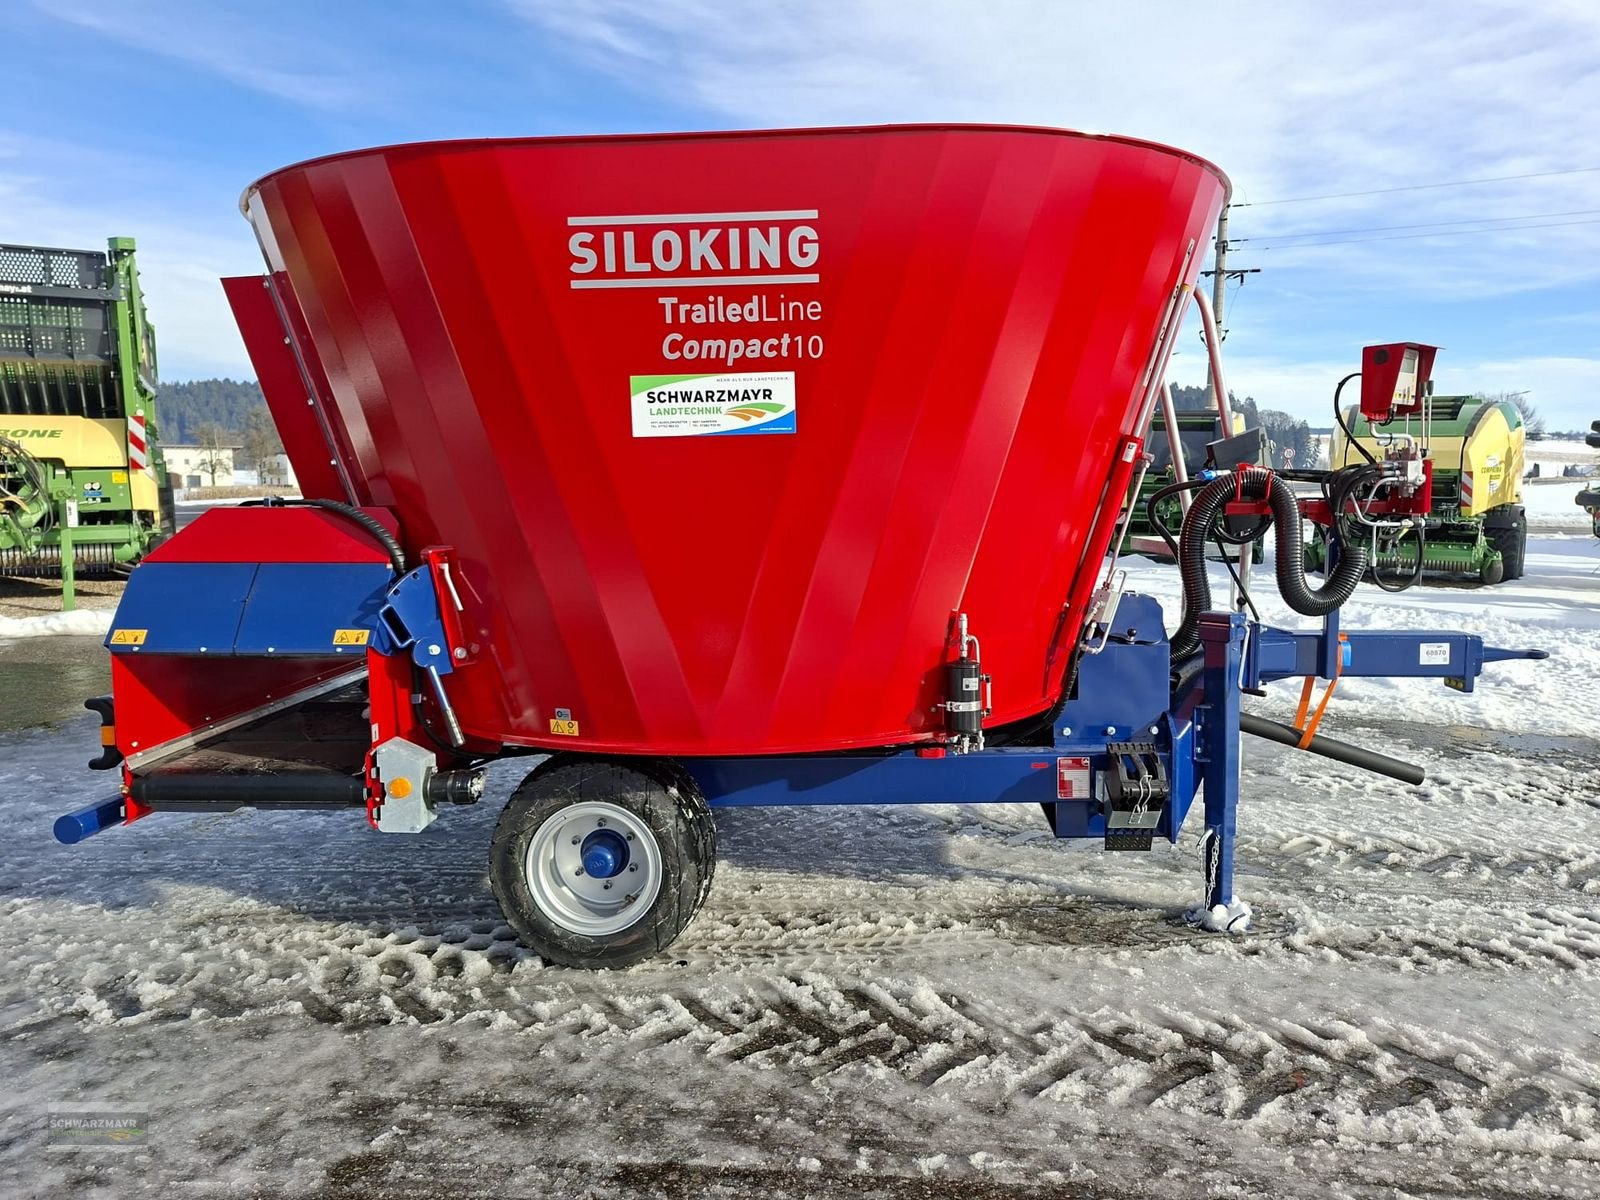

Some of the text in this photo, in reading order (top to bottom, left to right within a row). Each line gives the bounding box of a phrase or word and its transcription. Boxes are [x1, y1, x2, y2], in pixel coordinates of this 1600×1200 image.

[567, 225, 820, 274] SILOKING
[658, 294, 822, 324] TrailedLine
[646, 389, 773, 404] SCHWARZMAYR
[649, 406, 723, 416] LANDTECHNIK
